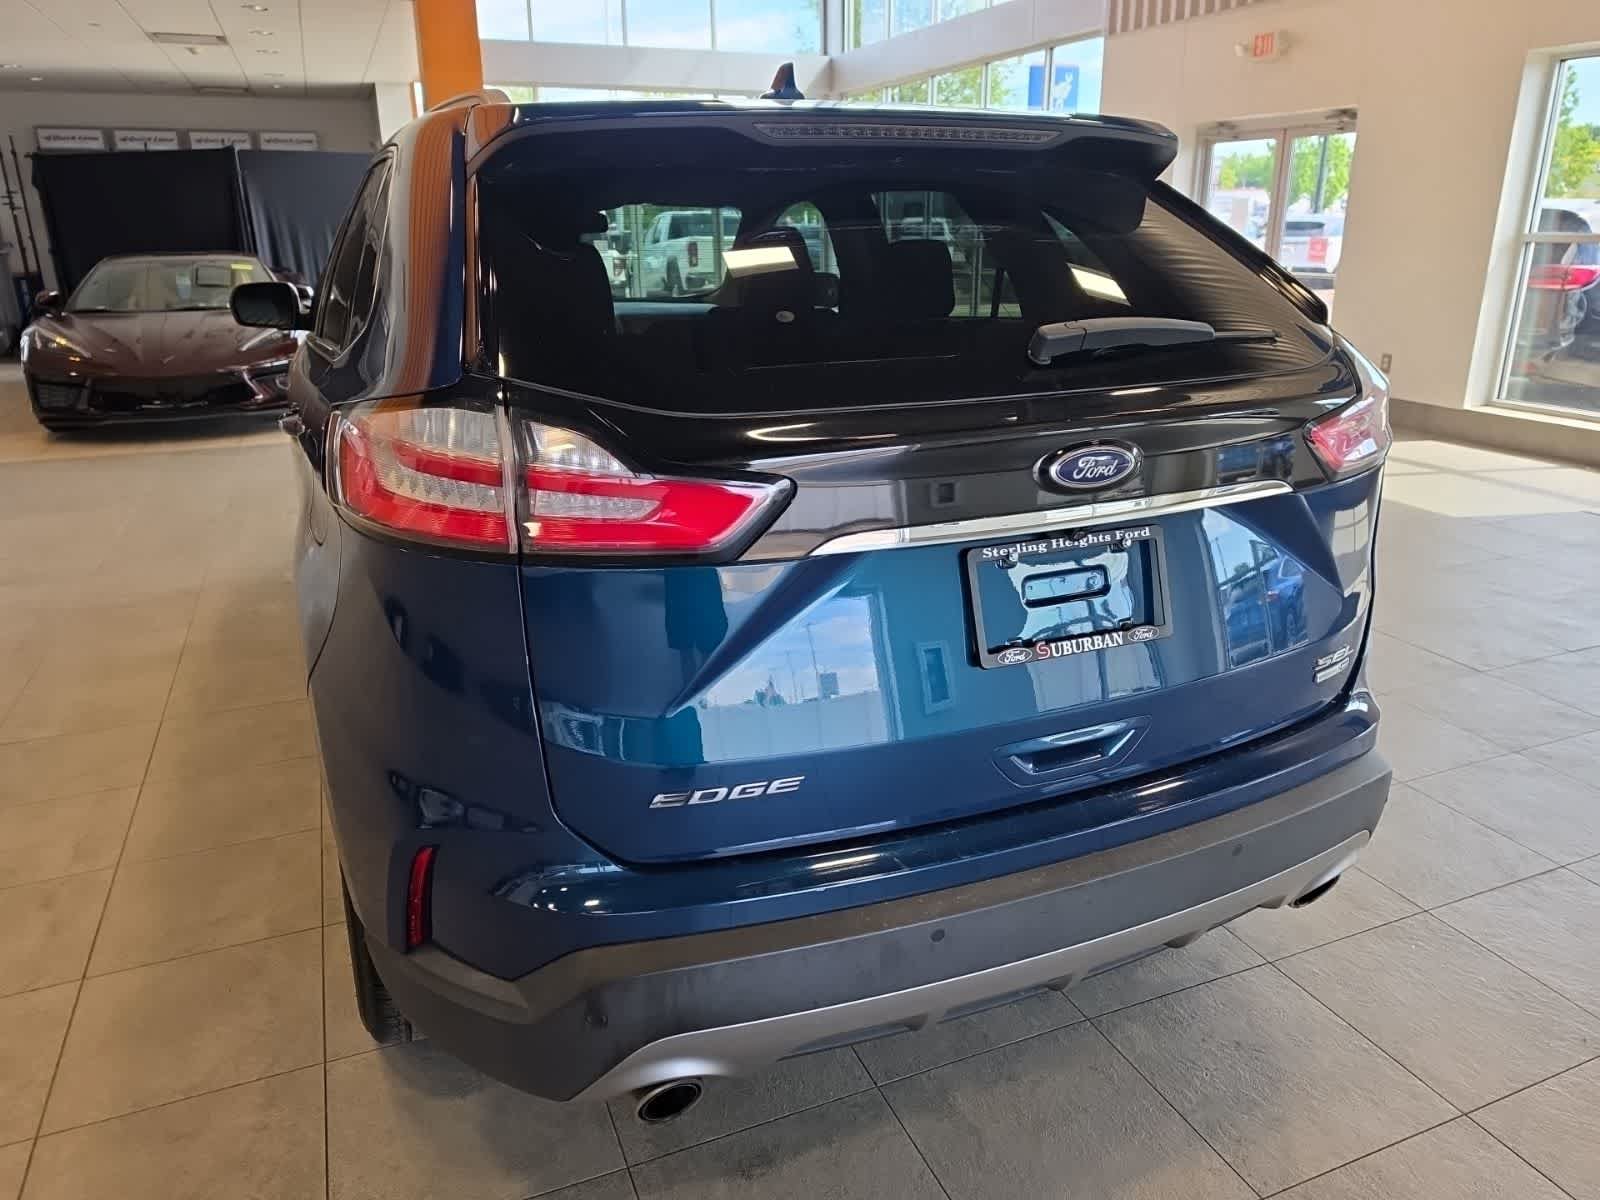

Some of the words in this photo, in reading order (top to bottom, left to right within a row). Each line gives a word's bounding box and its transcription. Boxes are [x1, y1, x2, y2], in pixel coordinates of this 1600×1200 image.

[1073, 456, 1117, 480] Ford
[983, 543, 1047, 559] Sterling
[1115, 527, 1150, 541] Ford
[1037, 632, 1124, 660] SUBURBAN
[649, 775, 805, 809] EDGE
